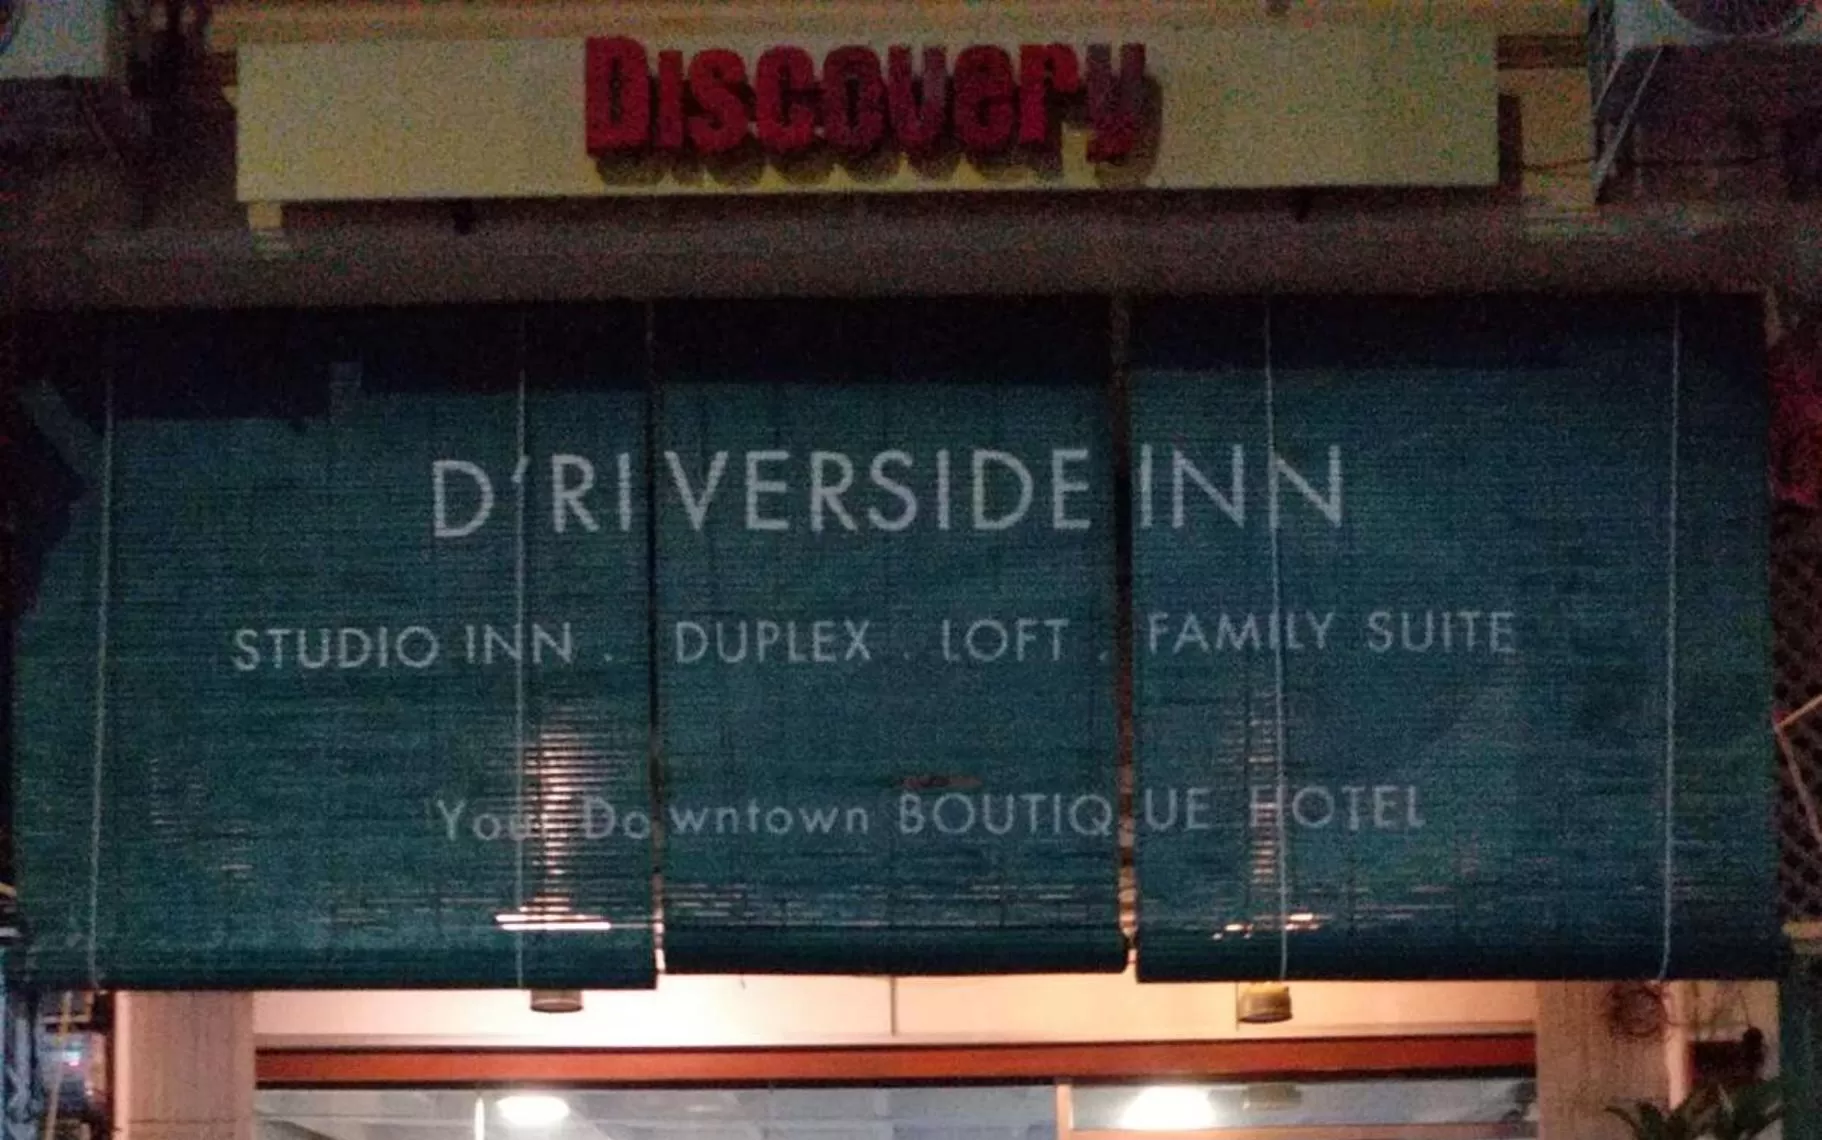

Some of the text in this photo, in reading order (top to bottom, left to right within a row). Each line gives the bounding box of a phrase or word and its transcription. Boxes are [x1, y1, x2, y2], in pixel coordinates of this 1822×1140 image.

[585, 35, 1148, 163] Discovery
[1138, 443, 1343, 530] INN
[230, 608, 1519, 672] STUDIO INN DUPLEX LOFT FAMILY SUITE
[898, 786, 1213, 838] BOUTIQUE
[1247, 783, 1427, 833] HOTEL
